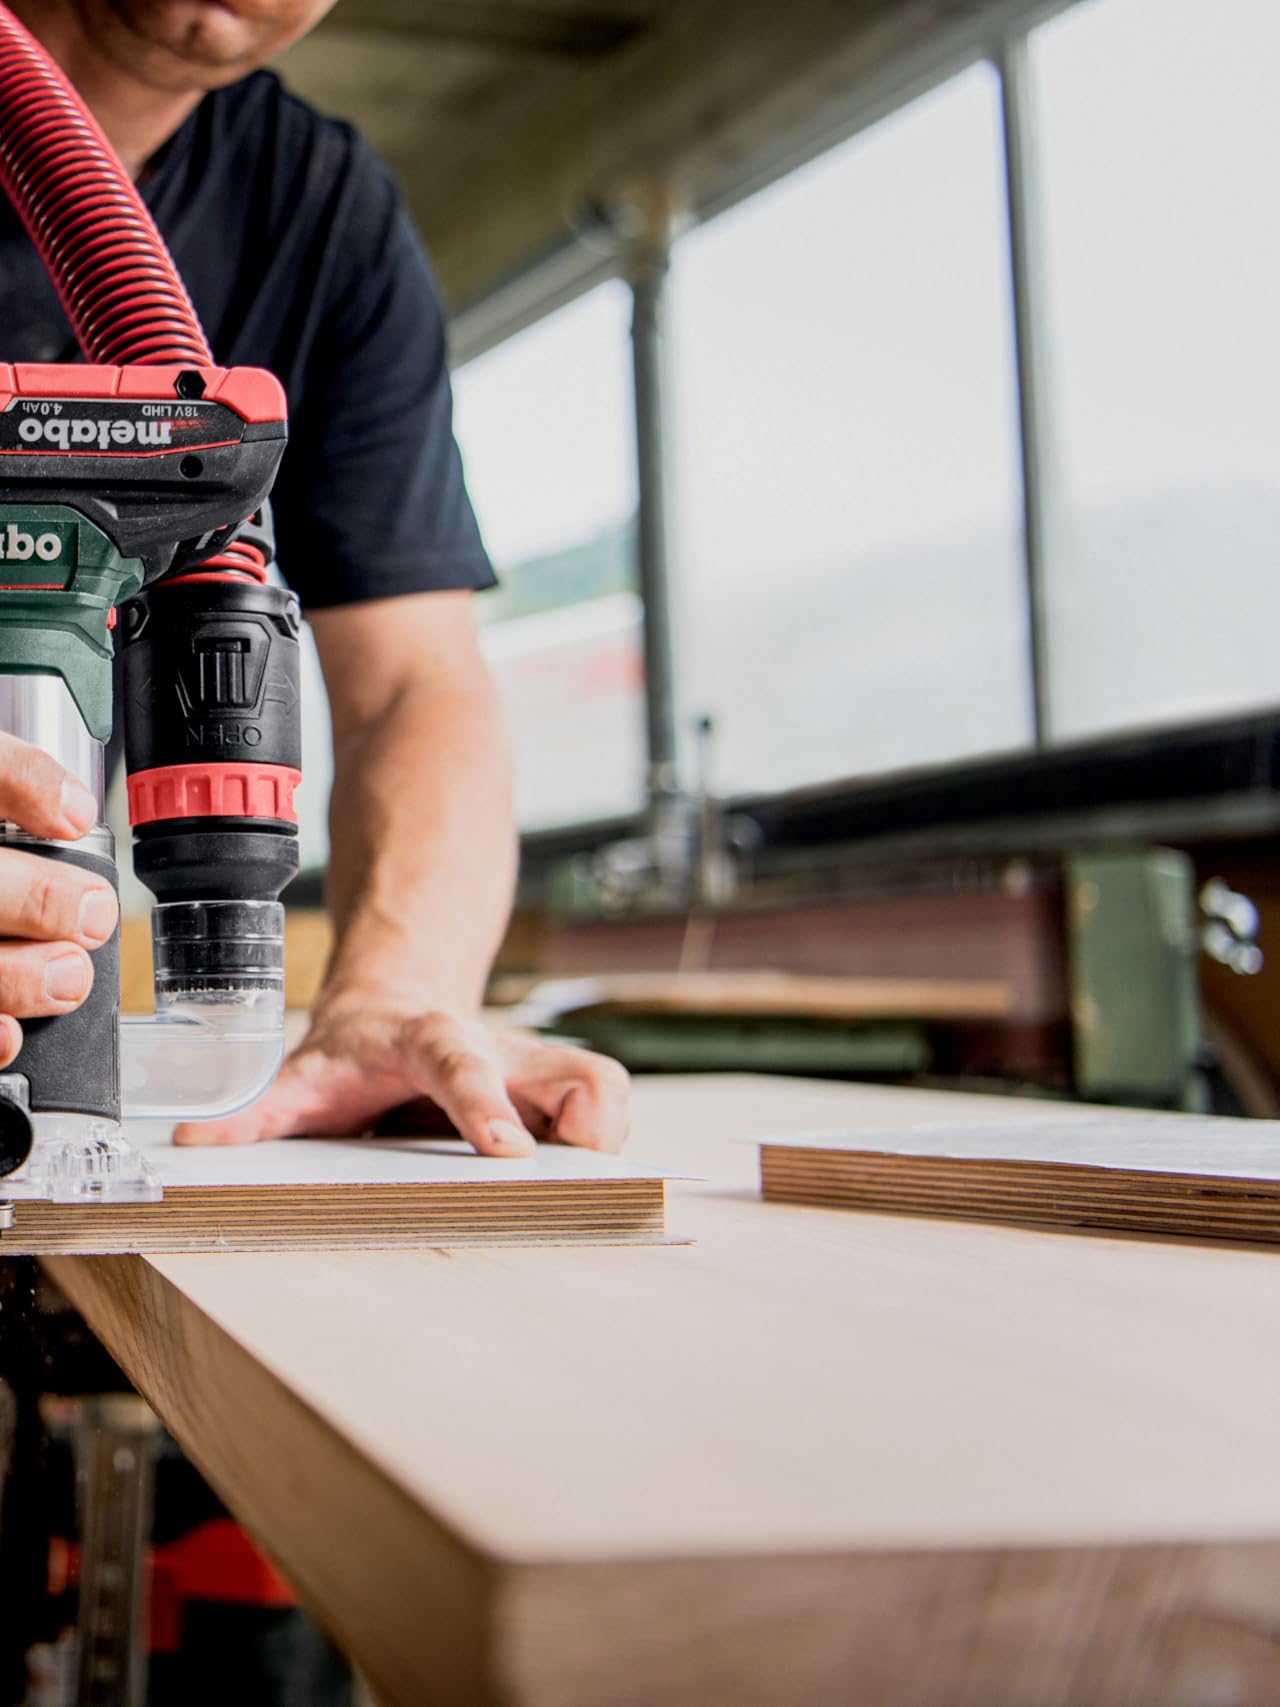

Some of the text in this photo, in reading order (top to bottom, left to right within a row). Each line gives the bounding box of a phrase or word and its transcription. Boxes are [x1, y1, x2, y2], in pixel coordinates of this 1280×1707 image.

[22, 402, 63, 415] 4.0Ah
[142, 405, 199, 417] 18V LiHD
[18, 418, 171, 449] metabo
